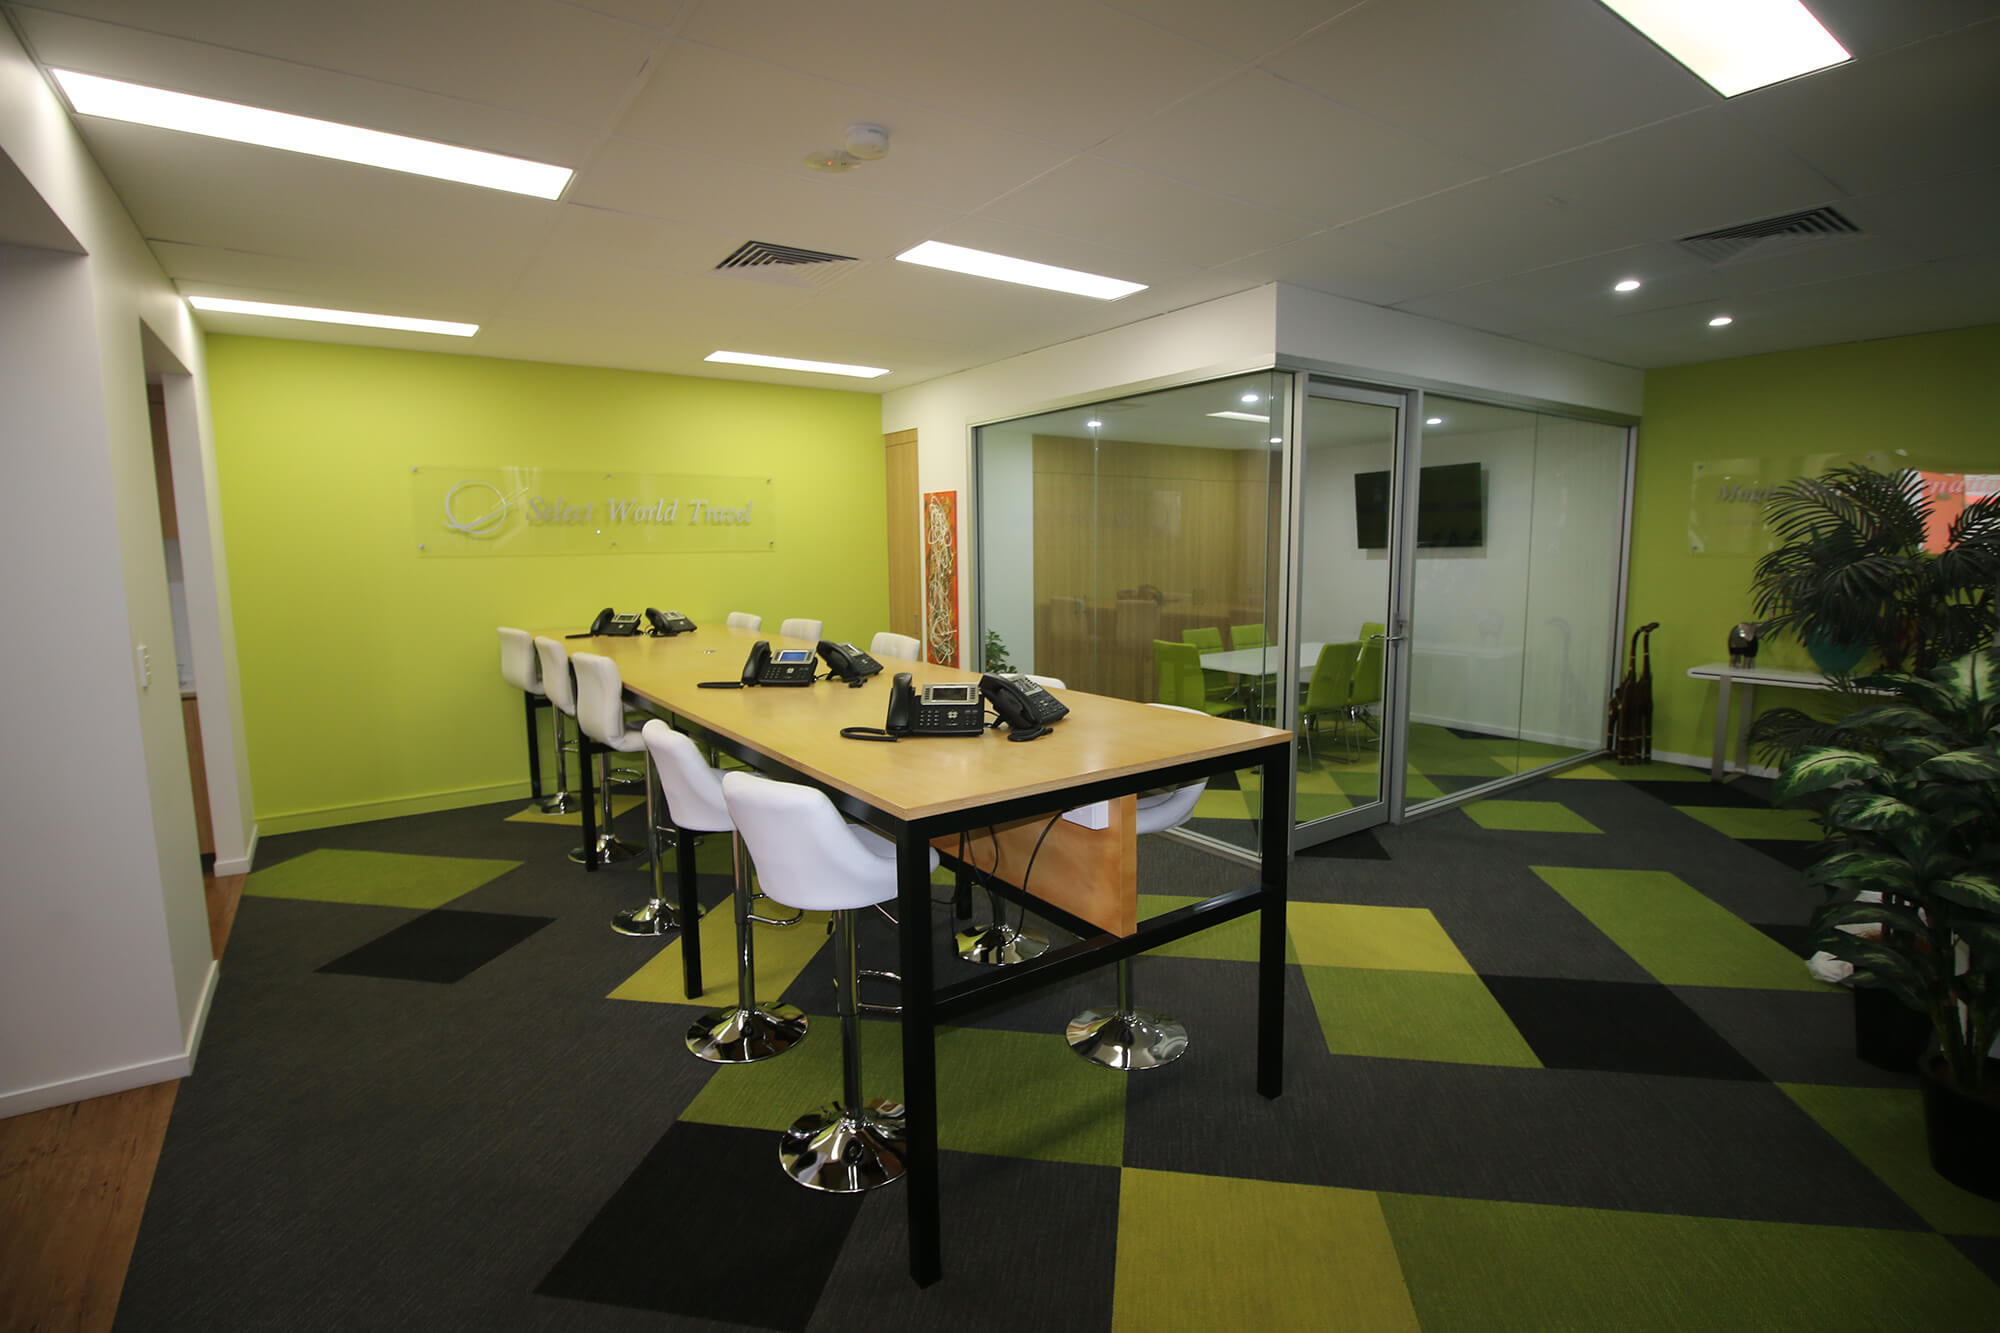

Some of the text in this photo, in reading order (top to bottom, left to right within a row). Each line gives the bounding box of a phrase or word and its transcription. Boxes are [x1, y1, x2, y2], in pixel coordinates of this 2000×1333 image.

[525, 495, 753, 522] Select World Travel
